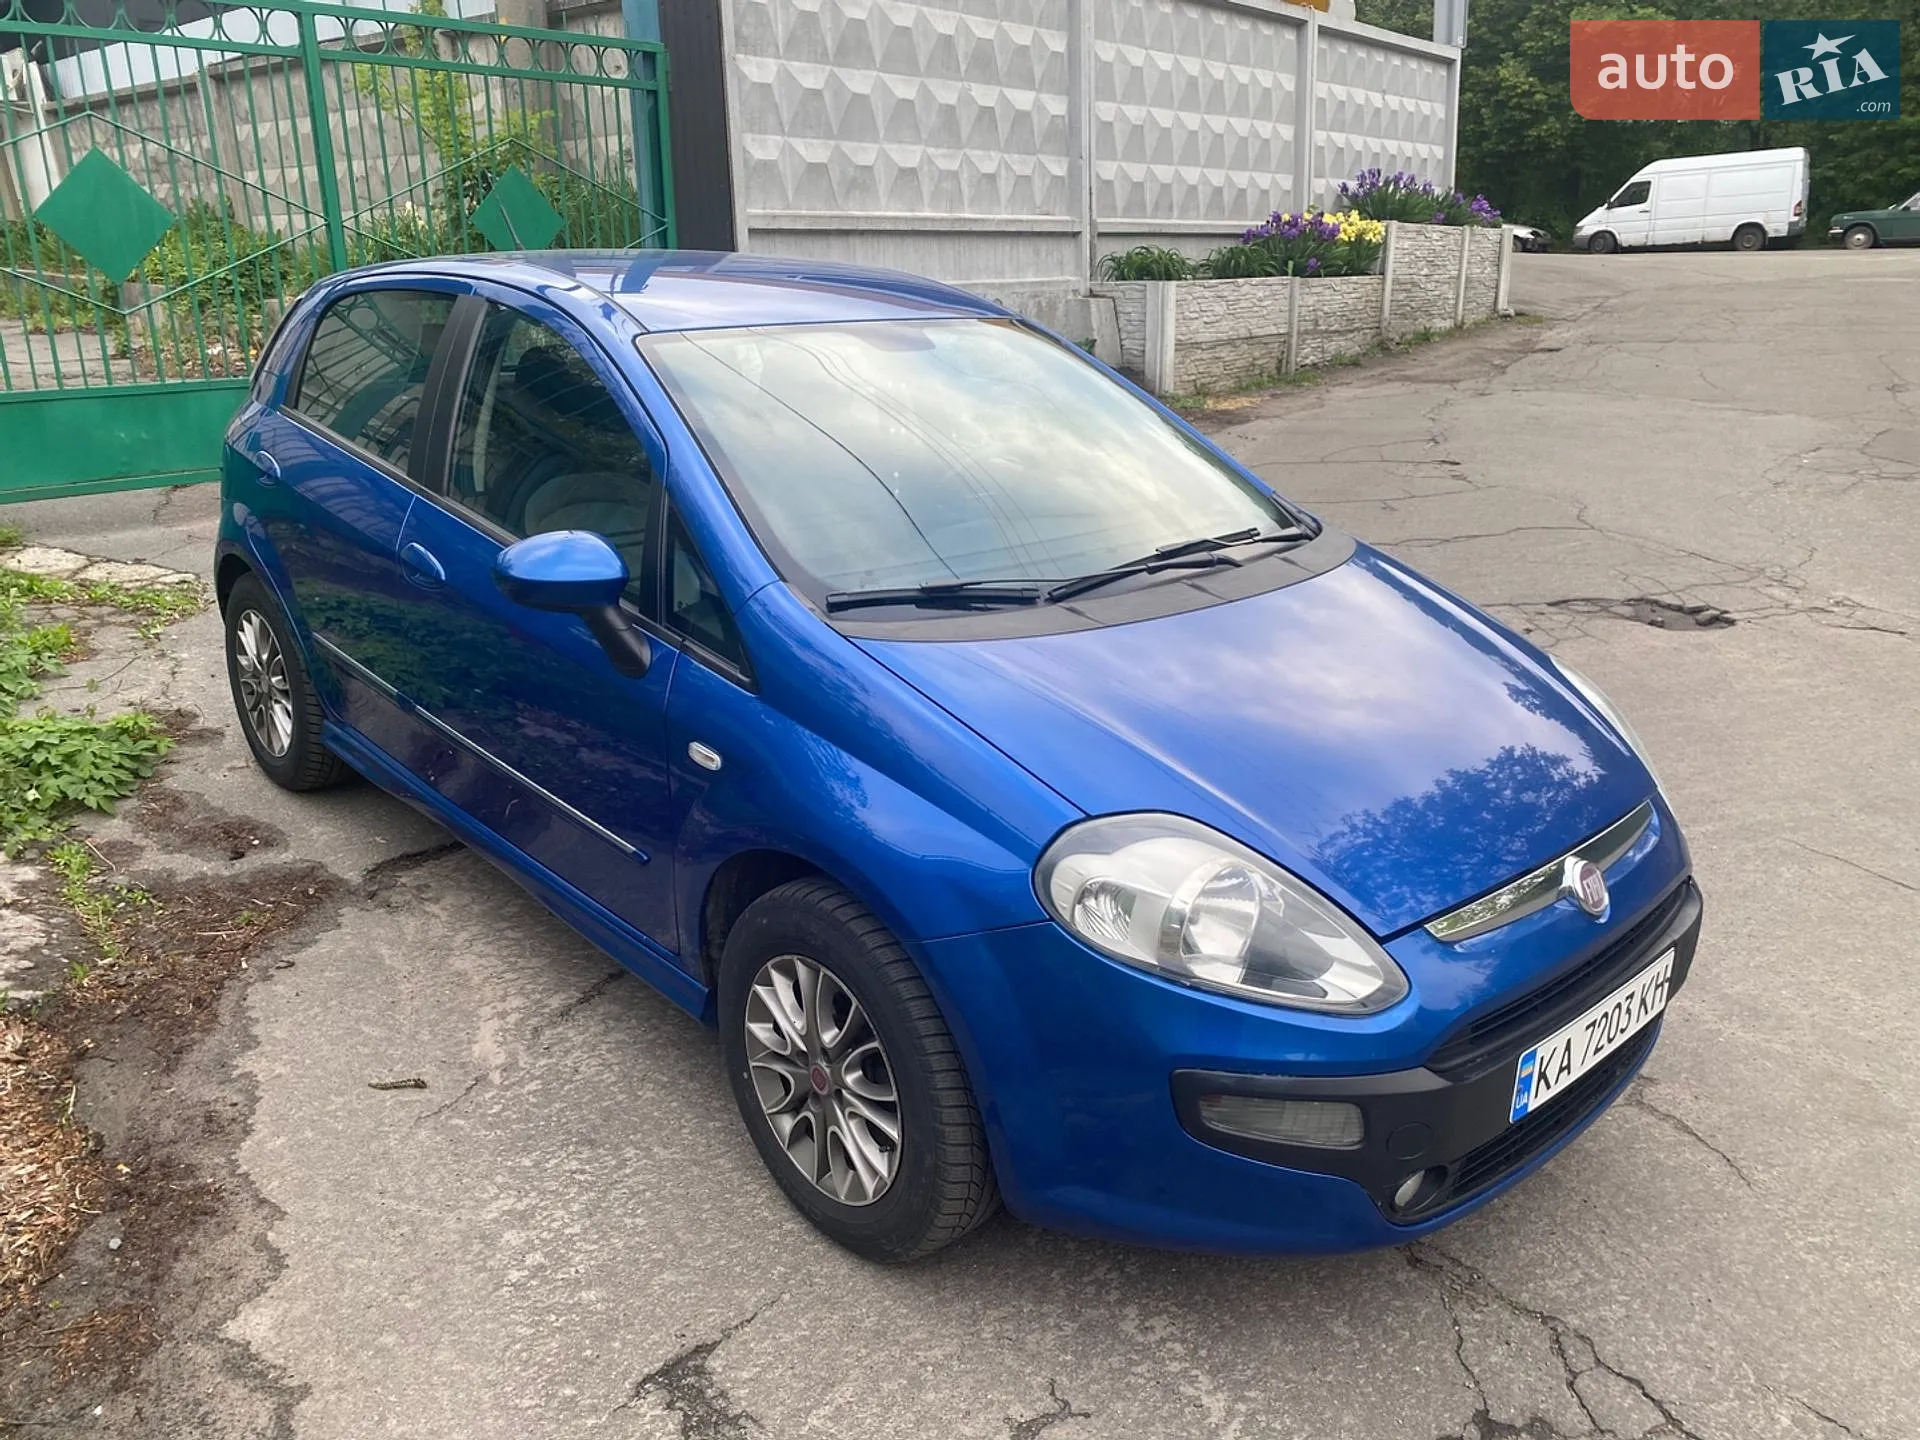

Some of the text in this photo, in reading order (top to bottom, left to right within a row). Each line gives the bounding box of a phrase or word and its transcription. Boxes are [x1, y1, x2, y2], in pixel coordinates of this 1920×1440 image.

[1534, 964, 1669, 1099] KA 7203 KH
